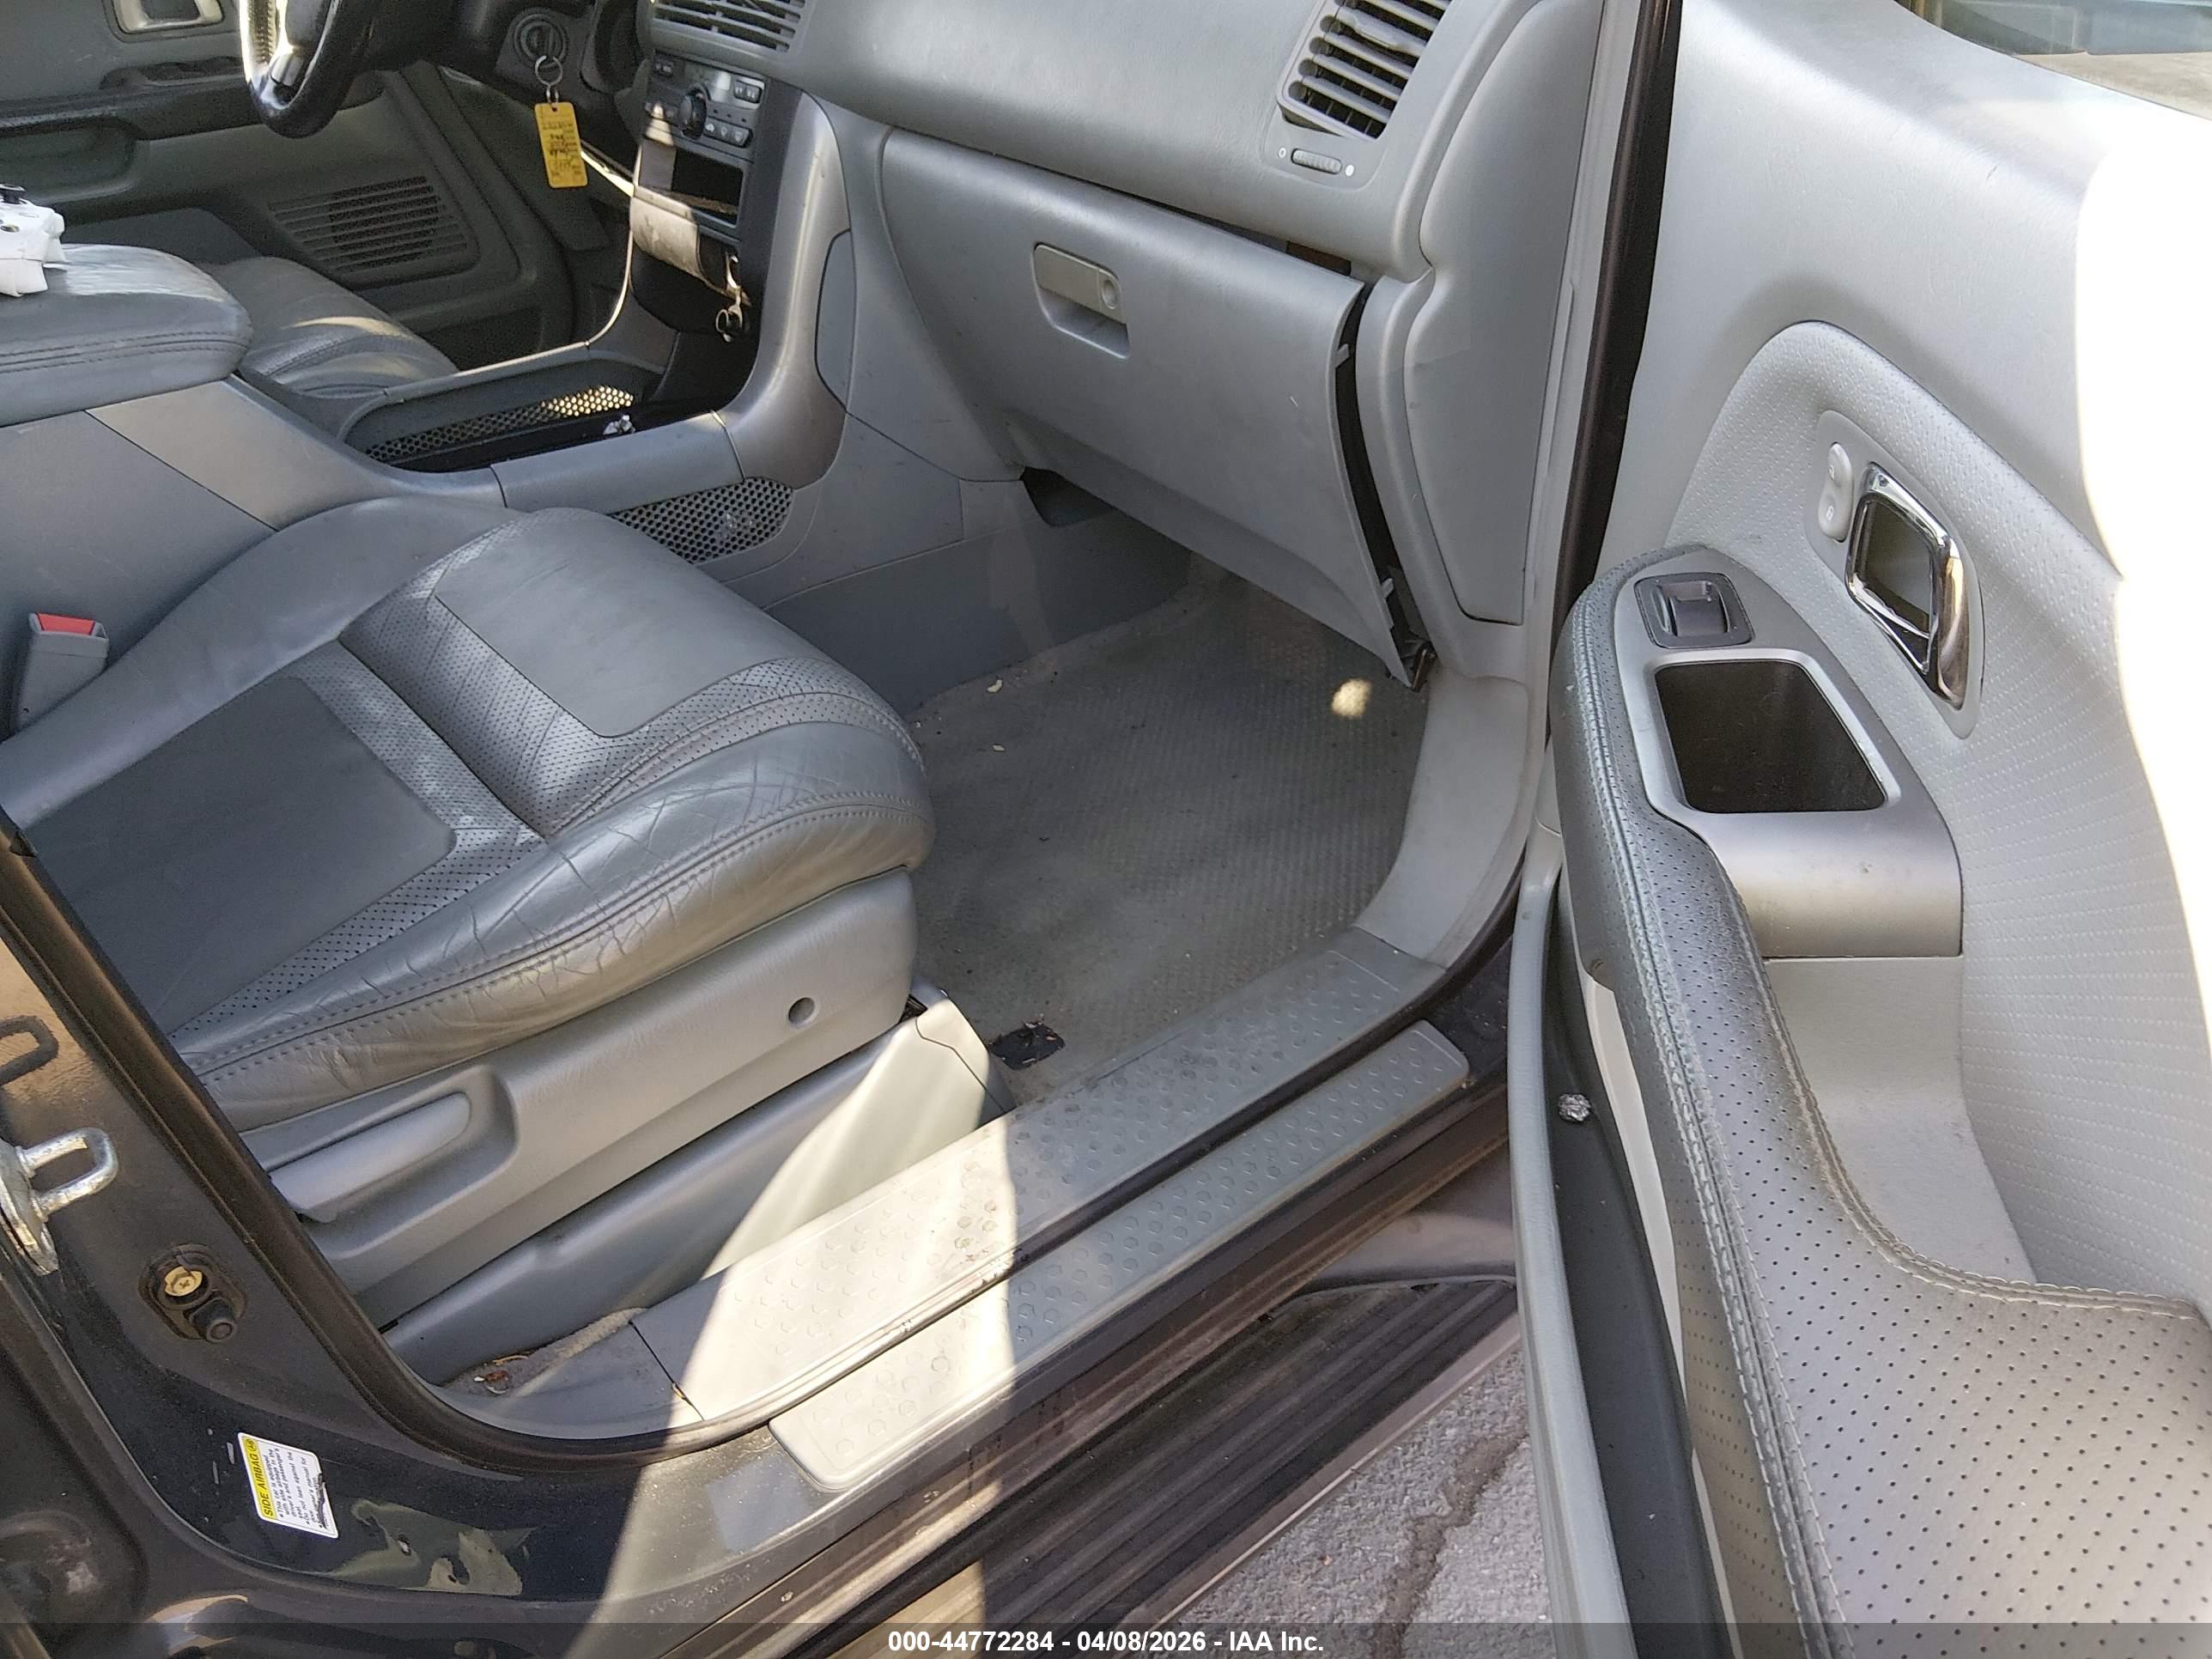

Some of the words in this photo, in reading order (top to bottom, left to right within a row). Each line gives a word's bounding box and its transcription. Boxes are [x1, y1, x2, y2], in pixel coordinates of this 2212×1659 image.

[249, 1453, 266, 1490] AIRBAG
[259, 1492, 273, 1516] SIDE
[275, 1499, 283, 1513] This
